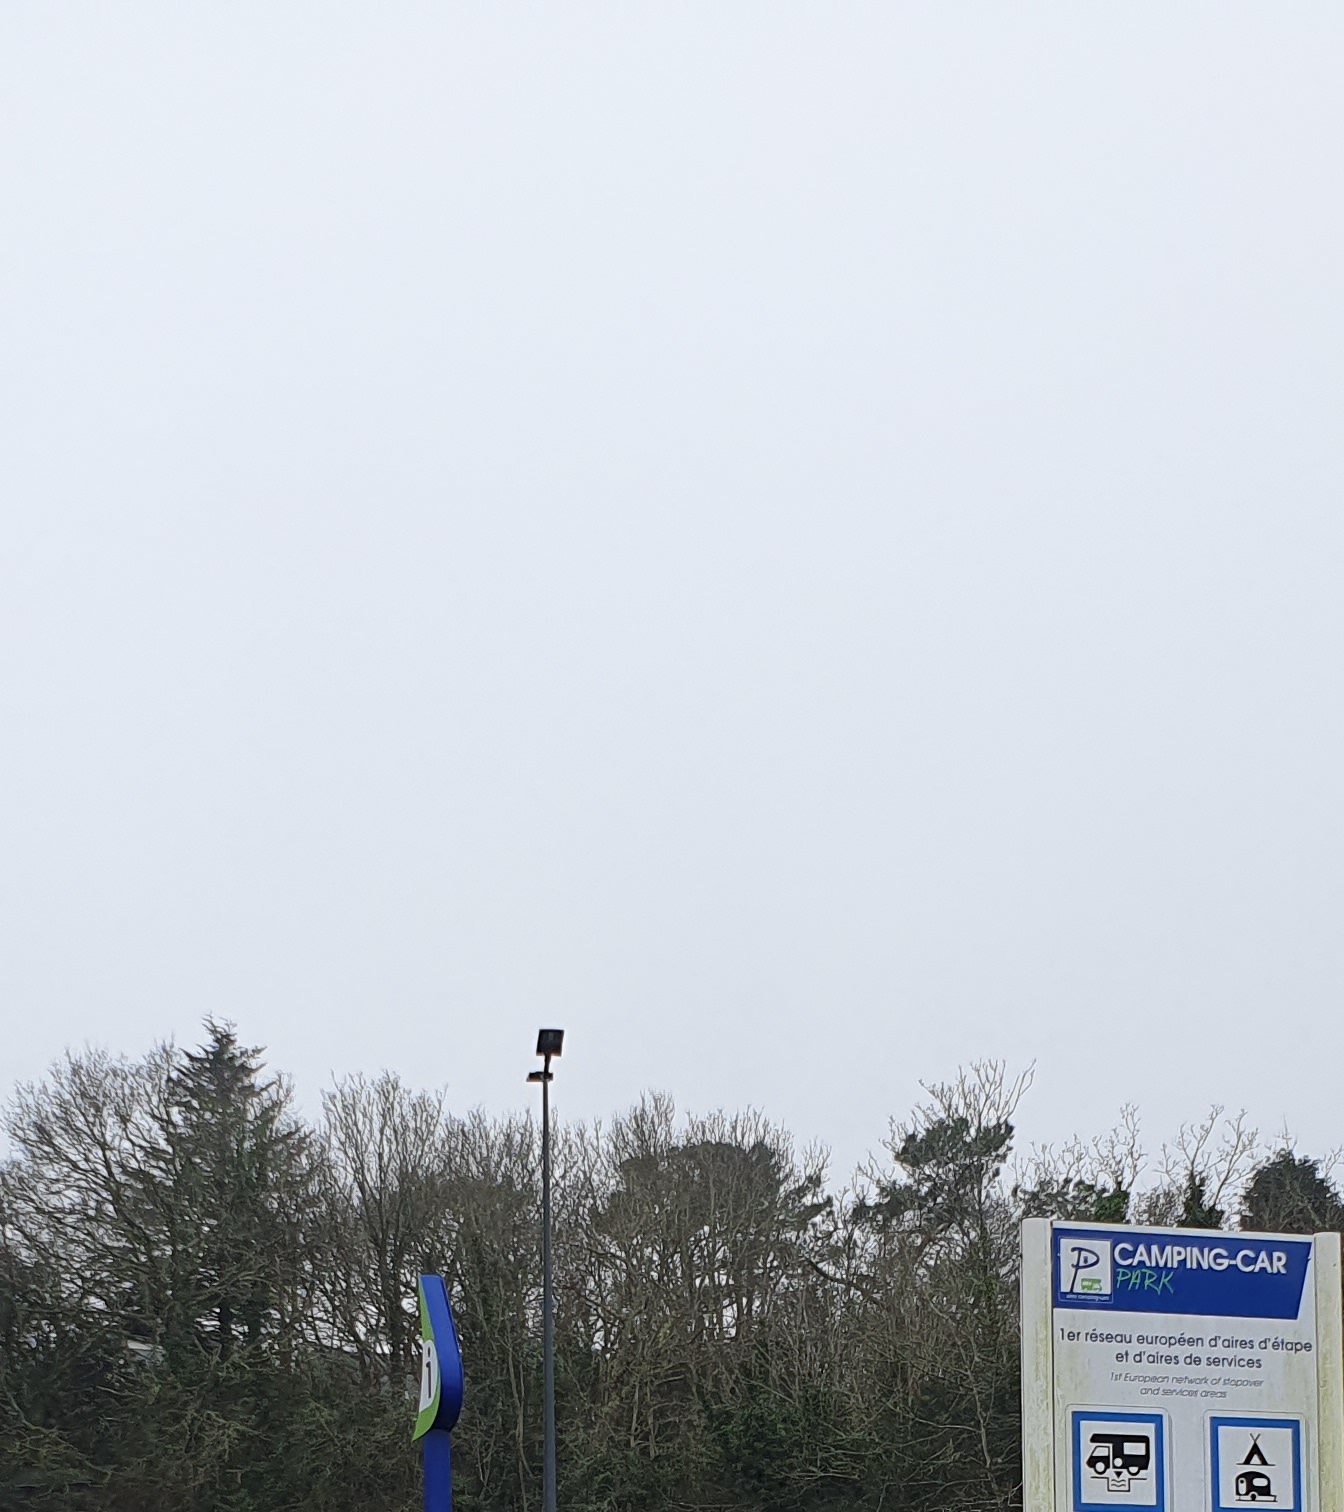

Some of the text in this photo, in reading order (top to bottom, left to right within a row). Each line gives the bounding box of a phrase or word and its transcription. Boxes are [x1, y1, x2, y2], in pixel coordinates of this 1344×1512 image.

[1113, 1242, 1287, 1274] CAMPING-CAR
[1116, 1268, 1175, 1295] PARK
[1060, 1328, 1313, 1354] 1er réseau européen d'aires d'étape
[1115, 1350, 1262, 1368] et d'aires de services
[1123, 1372, 1169, 1384] European
[1172, 1375, 1208, 1385] network
[1211, 1377, 1222, 1386] of
[1140, 1387, 1160, 1395] and
[1200, 1390, 1227, 1398] areas
